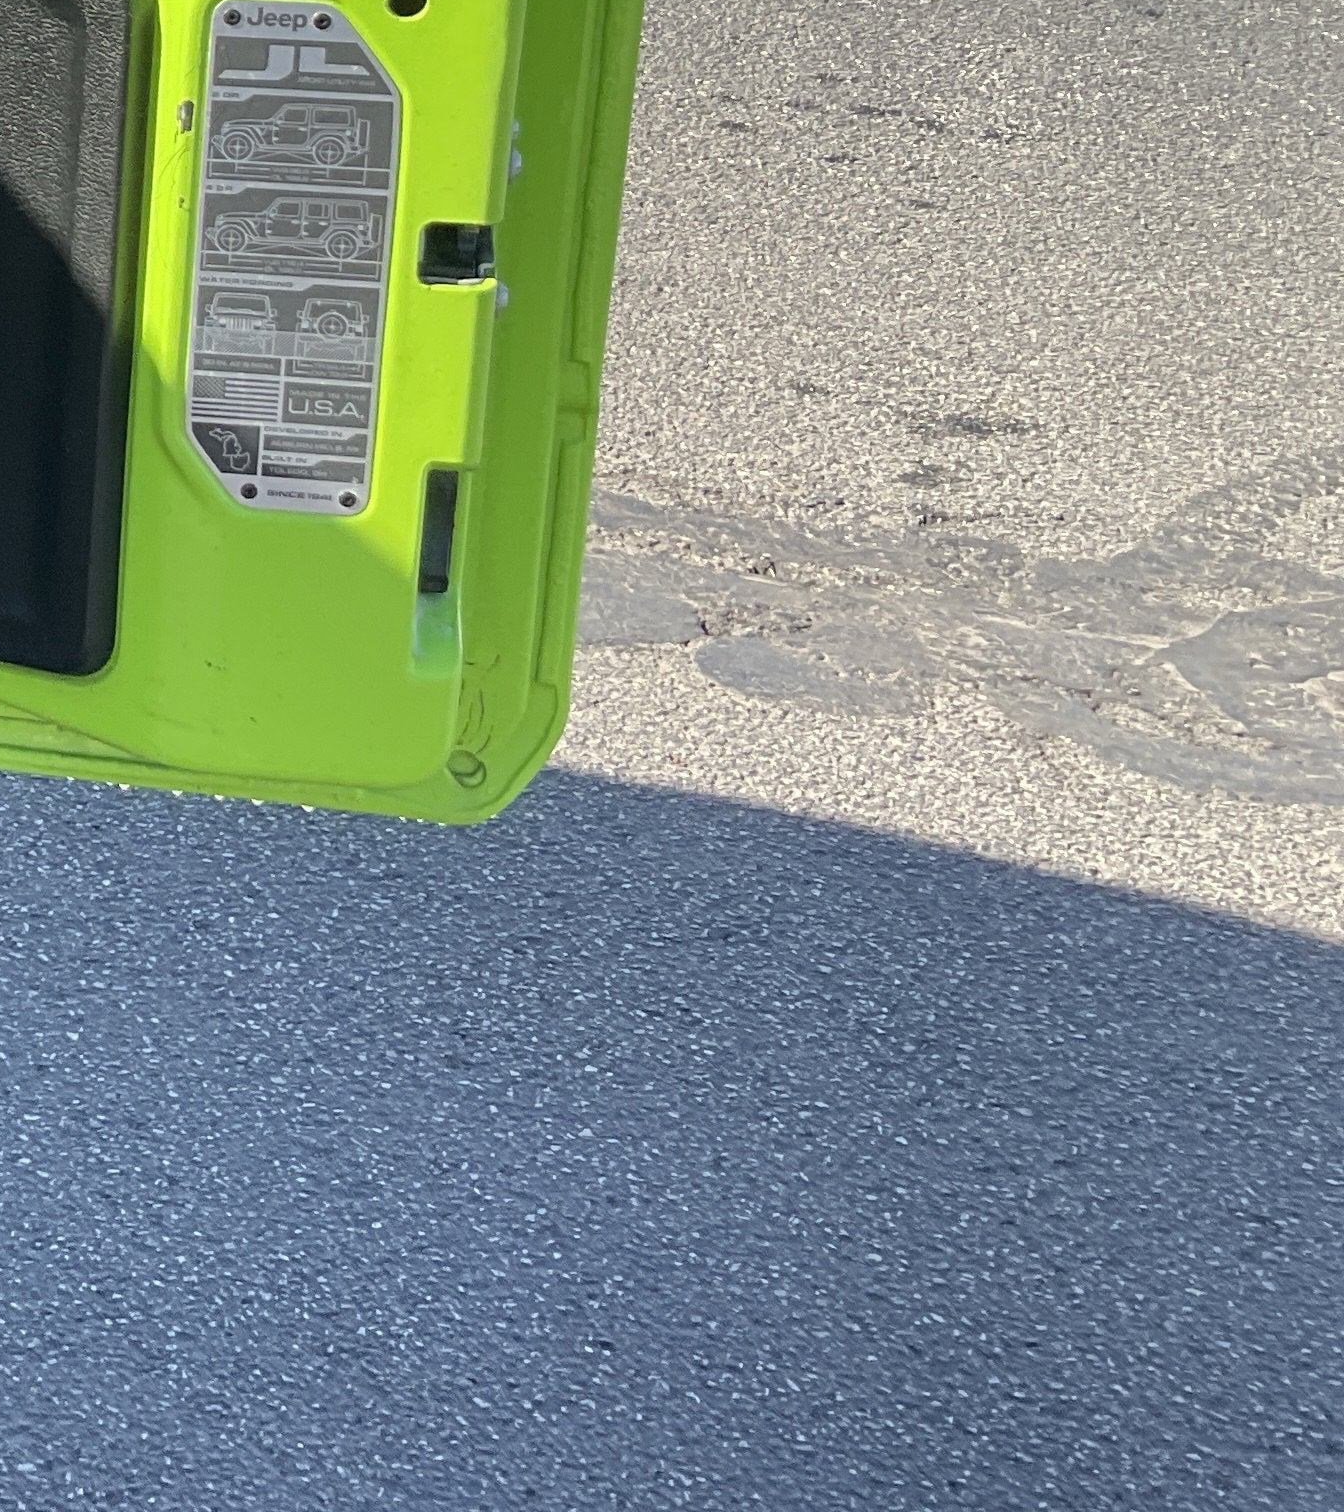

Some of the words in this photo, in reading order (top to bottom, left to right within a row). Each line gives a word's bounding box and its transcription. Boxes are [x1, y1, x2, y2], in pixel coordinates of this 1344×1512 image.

[247, 7, 308, 32] Jeep
[218, 44, 370, 81] JL
[199, 275, 240, 285] WATER
[288, 397, 365, 419] U.S.A.
[267, 489, 305, 499] SINCE
